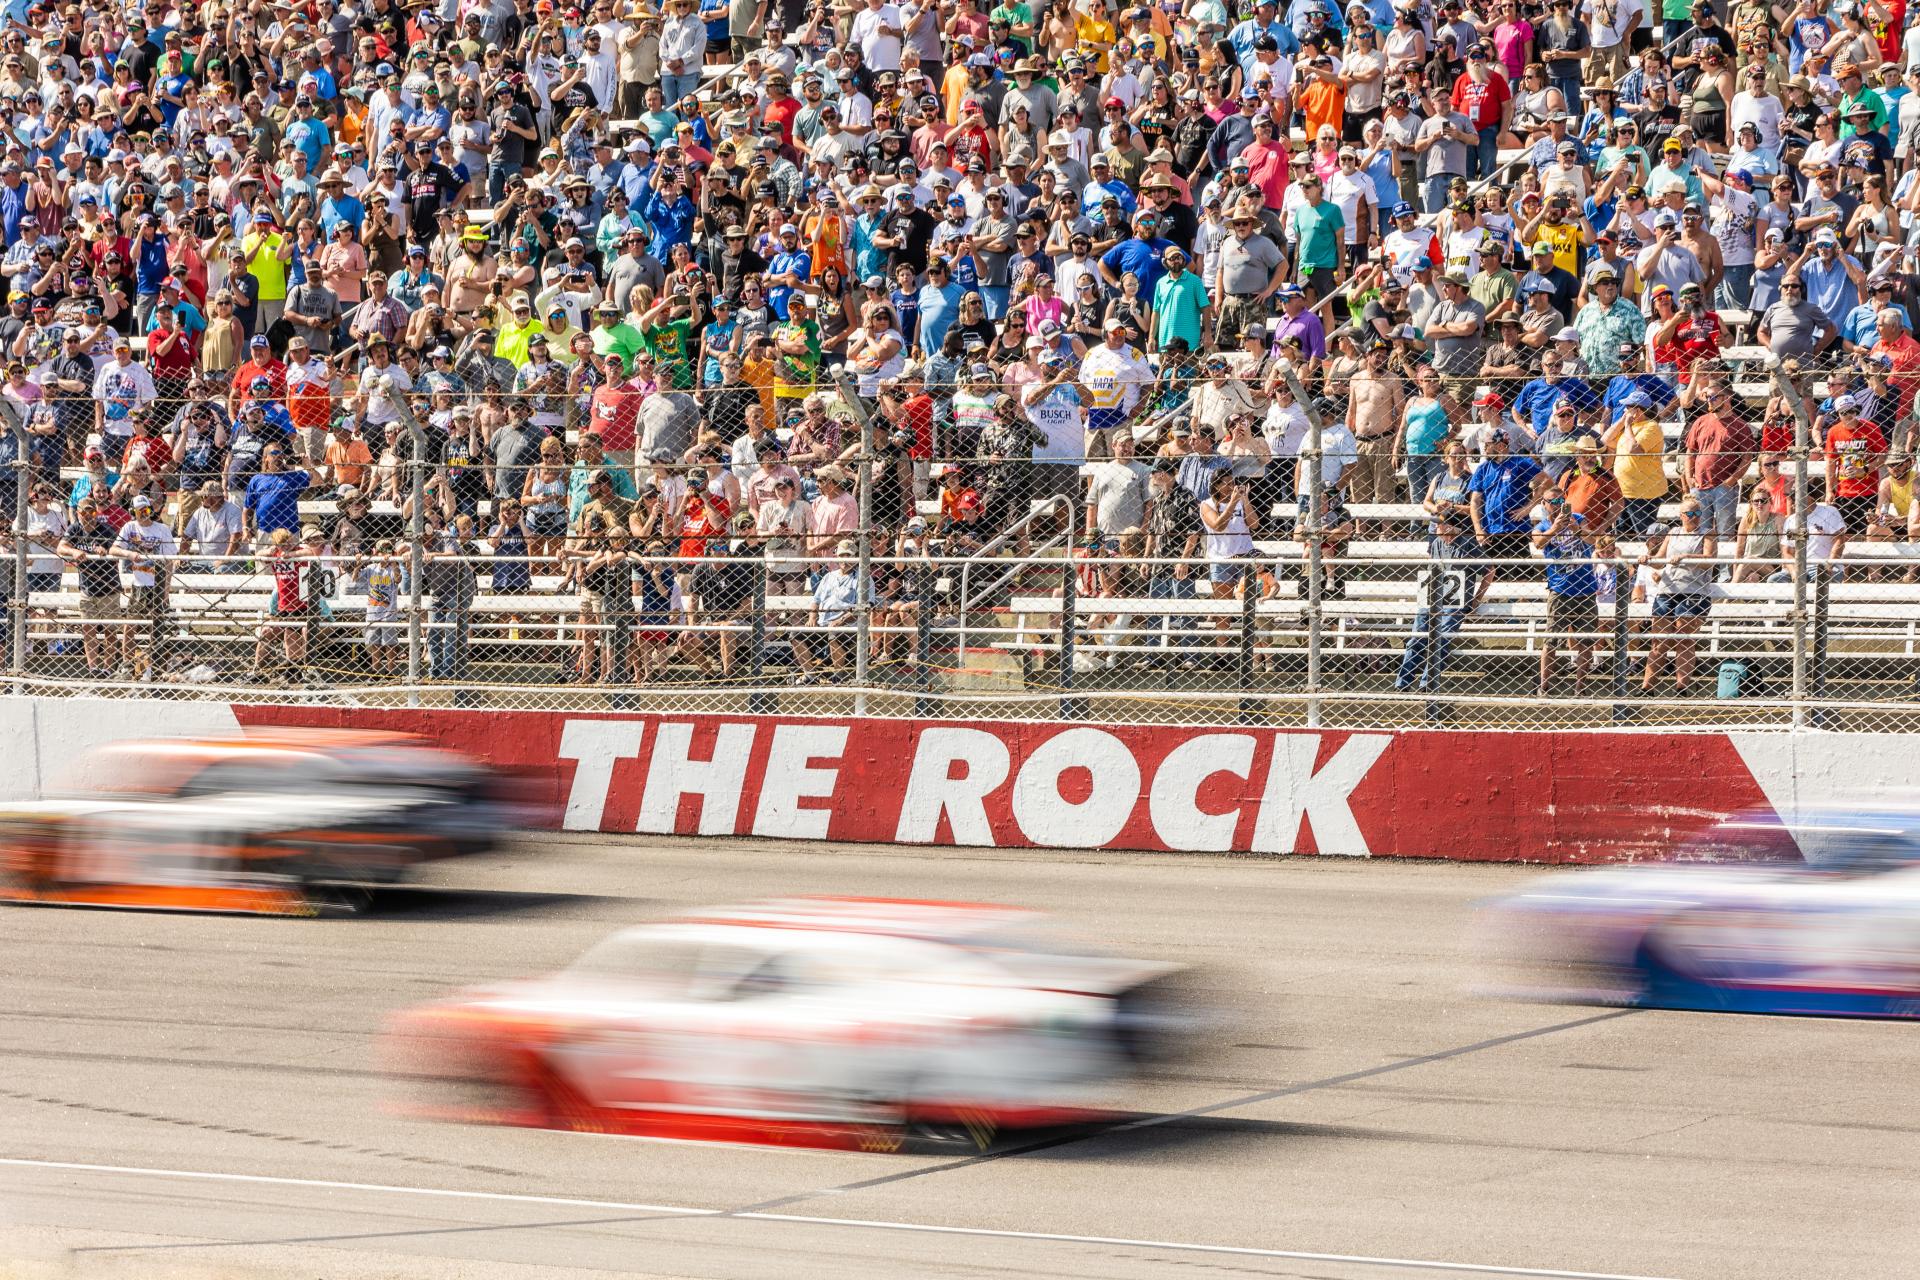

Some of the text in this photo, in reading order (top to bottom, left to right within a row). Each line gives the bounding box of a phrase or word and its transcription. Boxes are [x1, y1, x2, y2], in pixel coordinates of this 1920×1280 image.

[1093, 377, 1113, 389] NAPA
[1040, 409, 1072, 420] BUSCH
[558, 719, 1394, 857] THE ROCK
